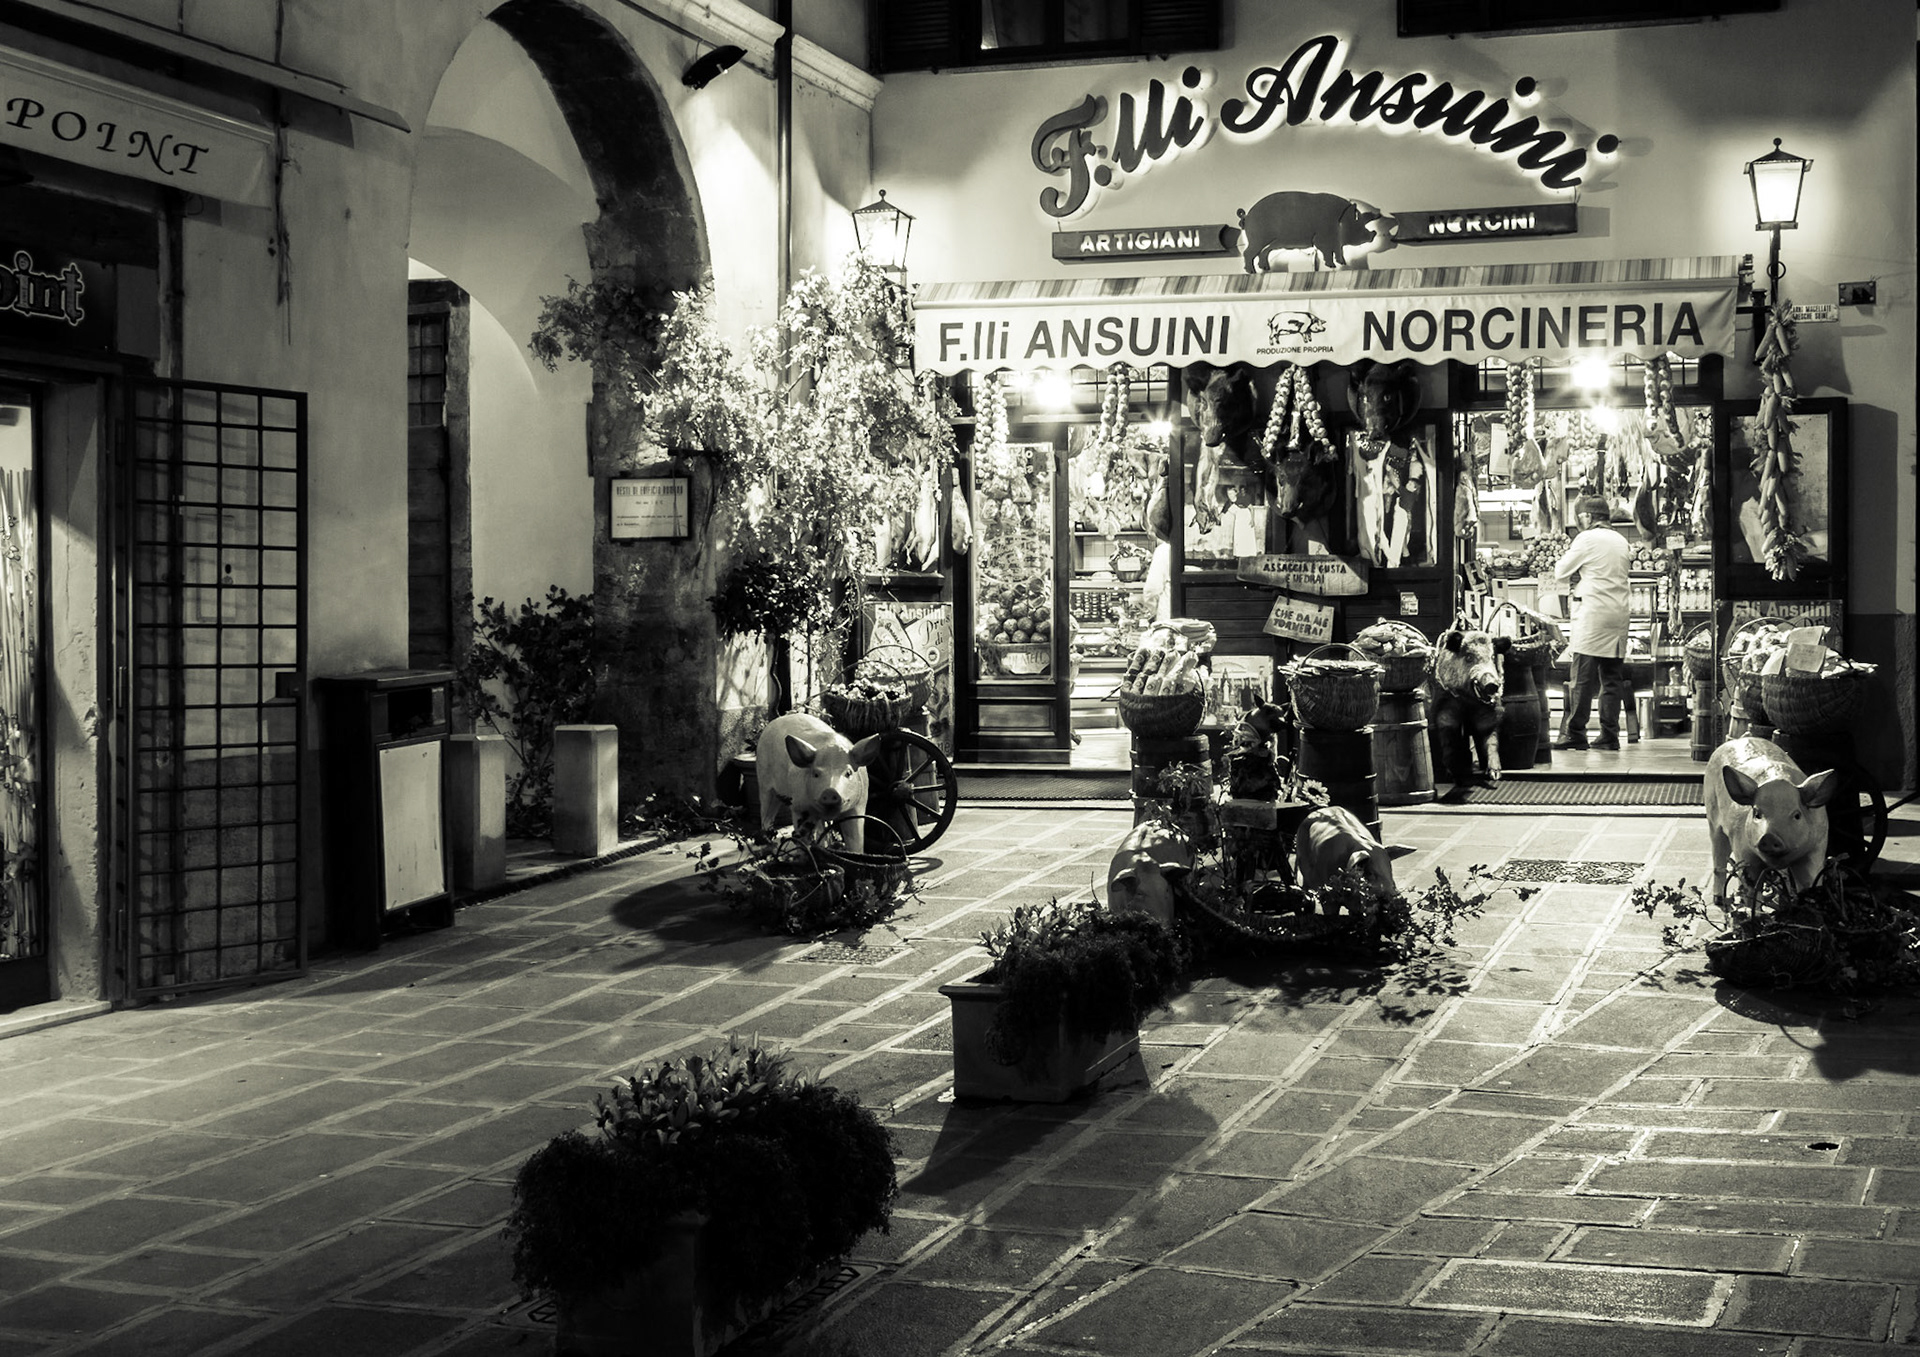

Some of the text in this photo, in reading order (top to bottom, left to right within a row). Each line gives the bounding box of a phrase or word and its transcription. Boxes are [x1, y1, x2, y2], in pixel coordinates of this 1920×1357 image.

[6, 97, 209, 175] POINT
[1031, 35, 1619, 217] F.lli Ansuini
[1428, 212, 1536, 235] NORCINI
[1081, 230, 1200, 252] ARTIGIANI
[1362, 302, 1704, 352] NORCINERIA
[939, 315, 1231, 362] F.lli ANSUINI
[1256, 346, 1301, 355] PRODUZIONE
[1318, 564, 1347, 574] GUSTA
[900, 604, 945, 620] Ansuini
[1275, 608, 1329, 628] CHE DA ME
[1766, 601, 1831, 617] Ansuini
[1274, 618, 1323, 636] TORNERAI
